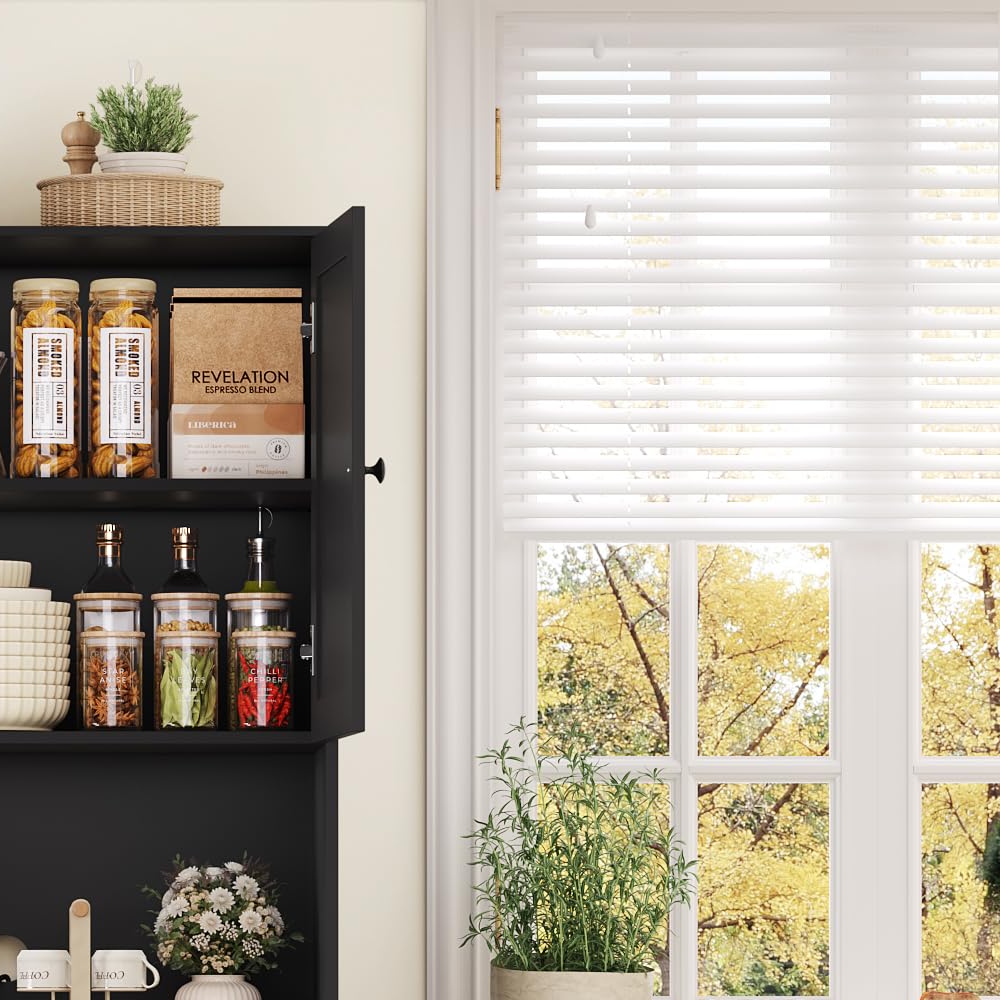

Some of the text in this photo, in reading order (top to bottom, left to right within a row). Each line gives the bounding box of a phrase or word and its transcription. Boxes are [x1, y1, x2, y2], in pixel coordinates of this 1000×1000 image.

[51, 338, 62, 378] SMOKED
[128, 338, 139, 378] SMOKED
[191, 370, 289, 384] REVELATION
[205, 386, 277, 394] ESPRESSO BLEND
[248, 676, 283, 684] PEPPER
